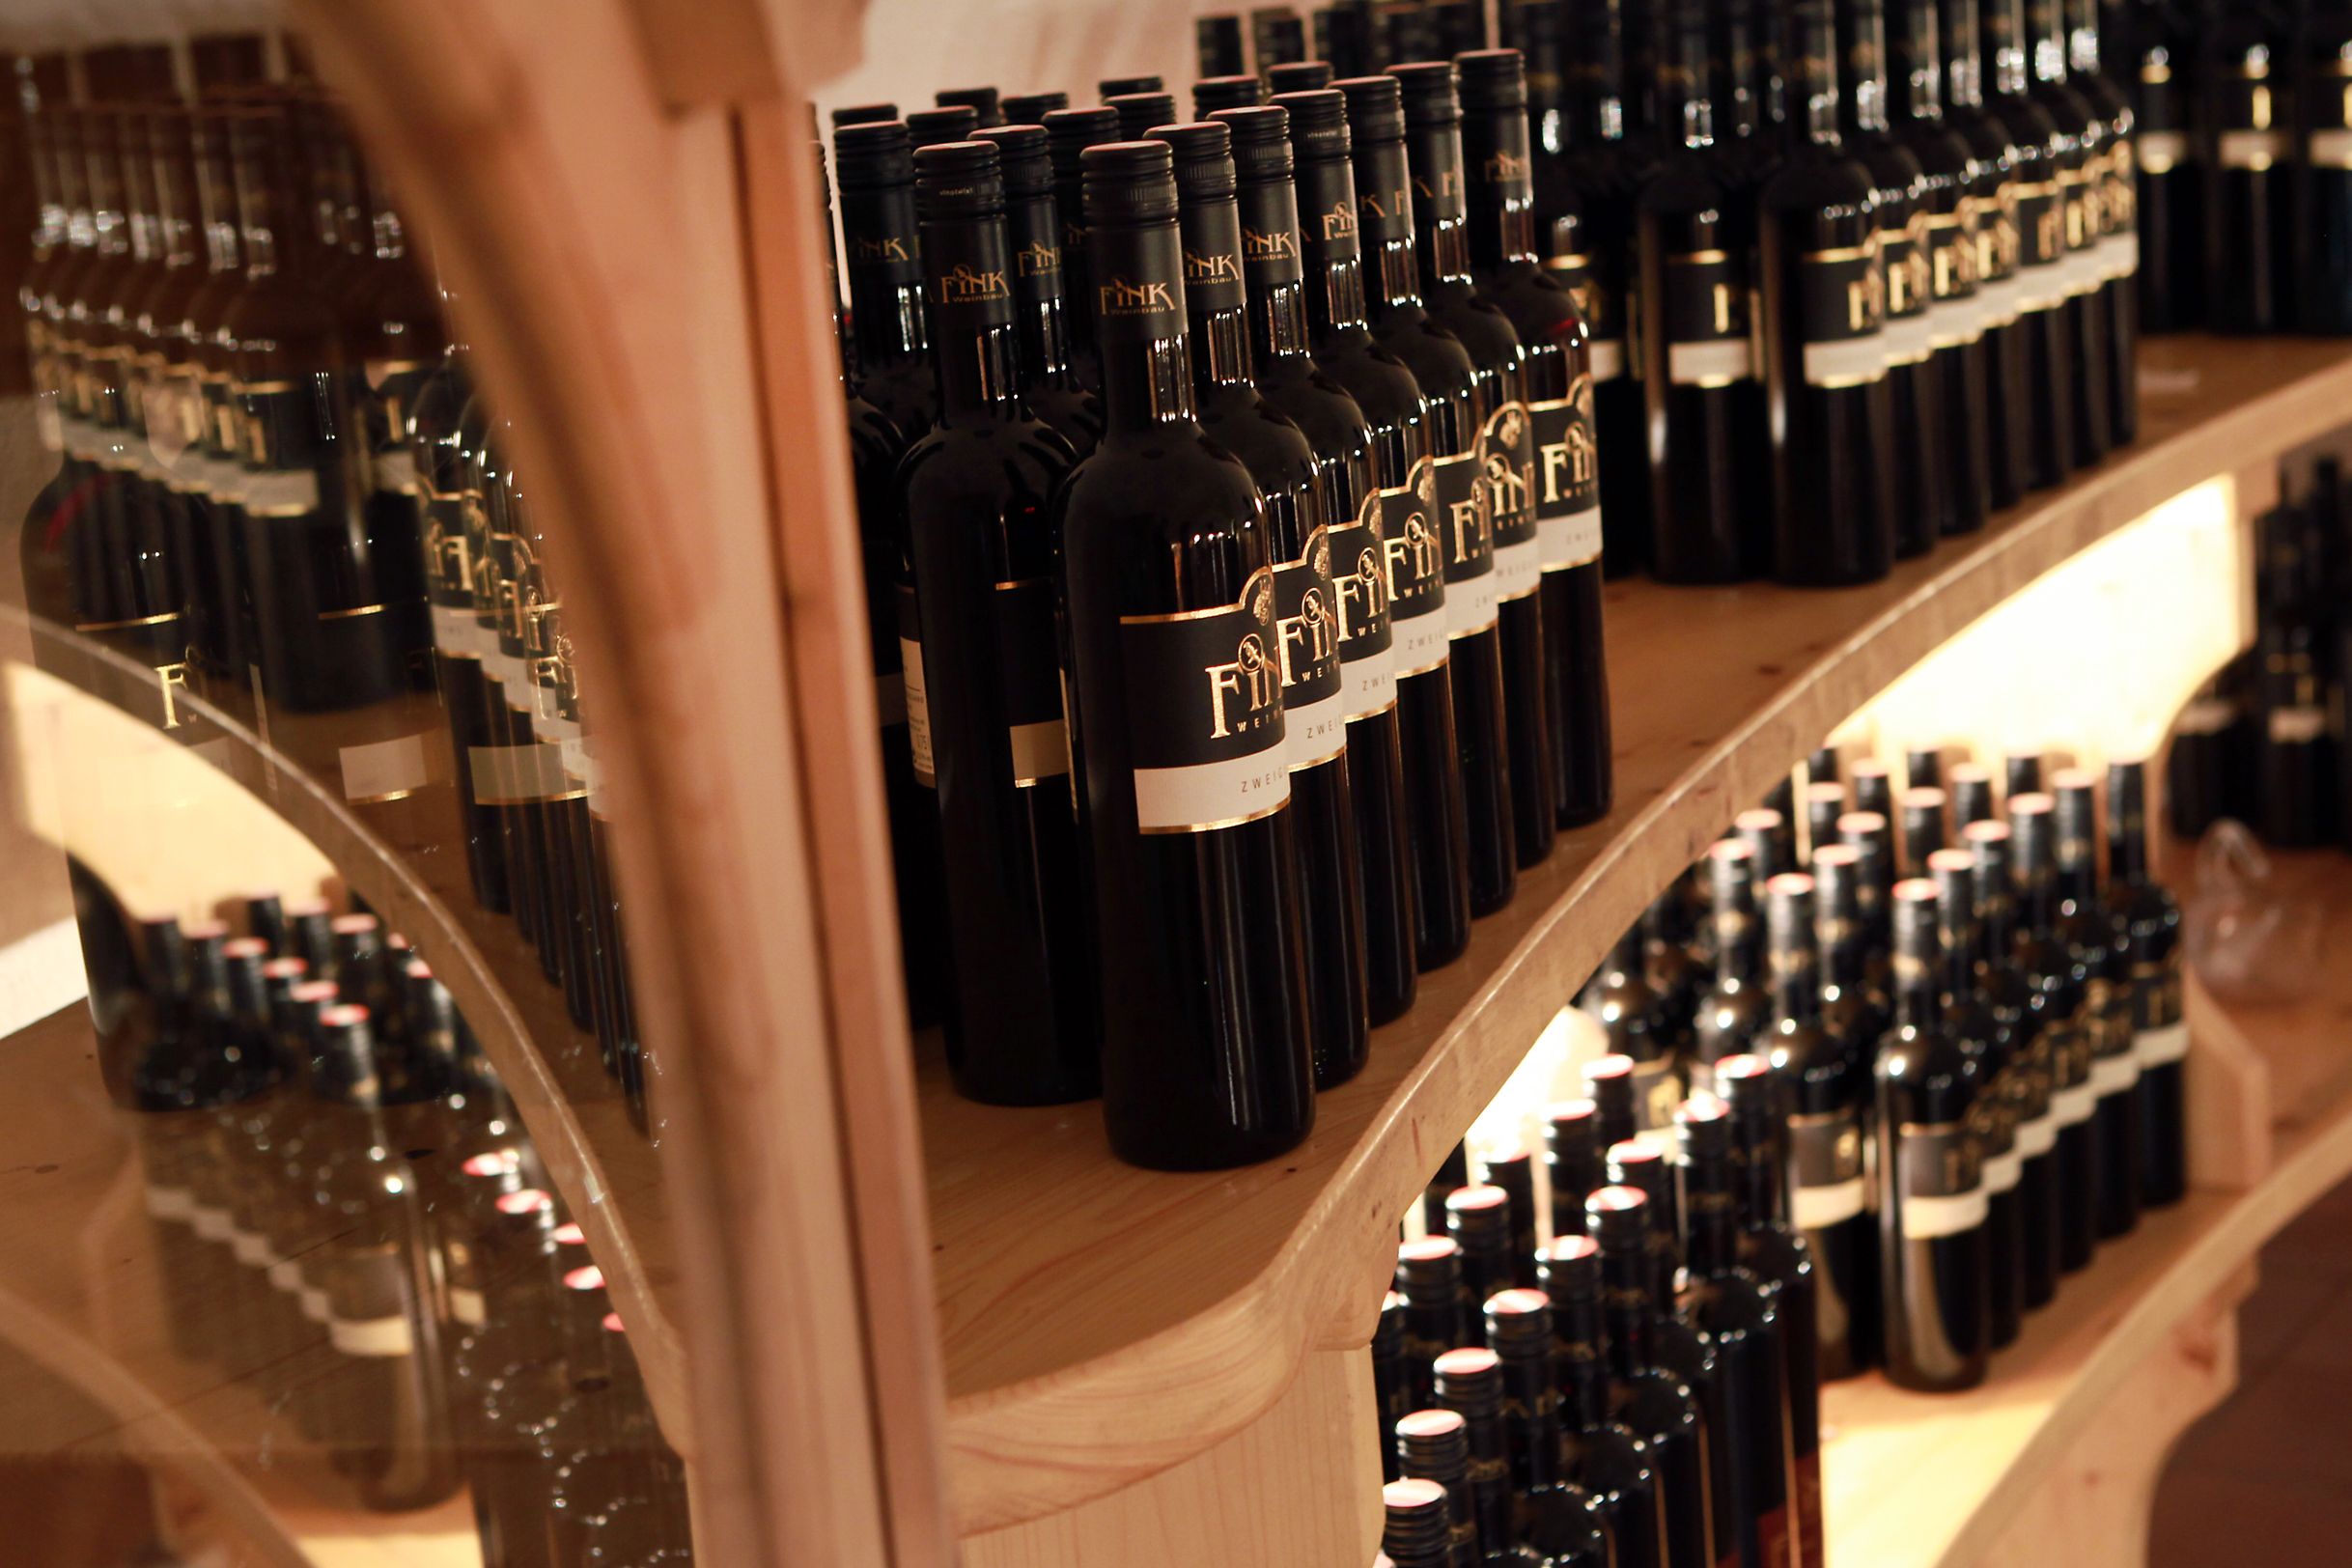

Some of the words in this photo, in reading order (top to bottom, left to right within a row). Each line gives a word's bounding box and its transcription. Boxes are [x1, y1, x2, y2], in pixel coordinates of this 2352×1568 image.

[1244, 225, 1297, 257] INK
[941, 264, 1010, 303] FINK
[1185, 252, 1240, 281] INK
[1100, 276, 1176, 316] FINK
[1205, 634, 1282, 740] FIN
